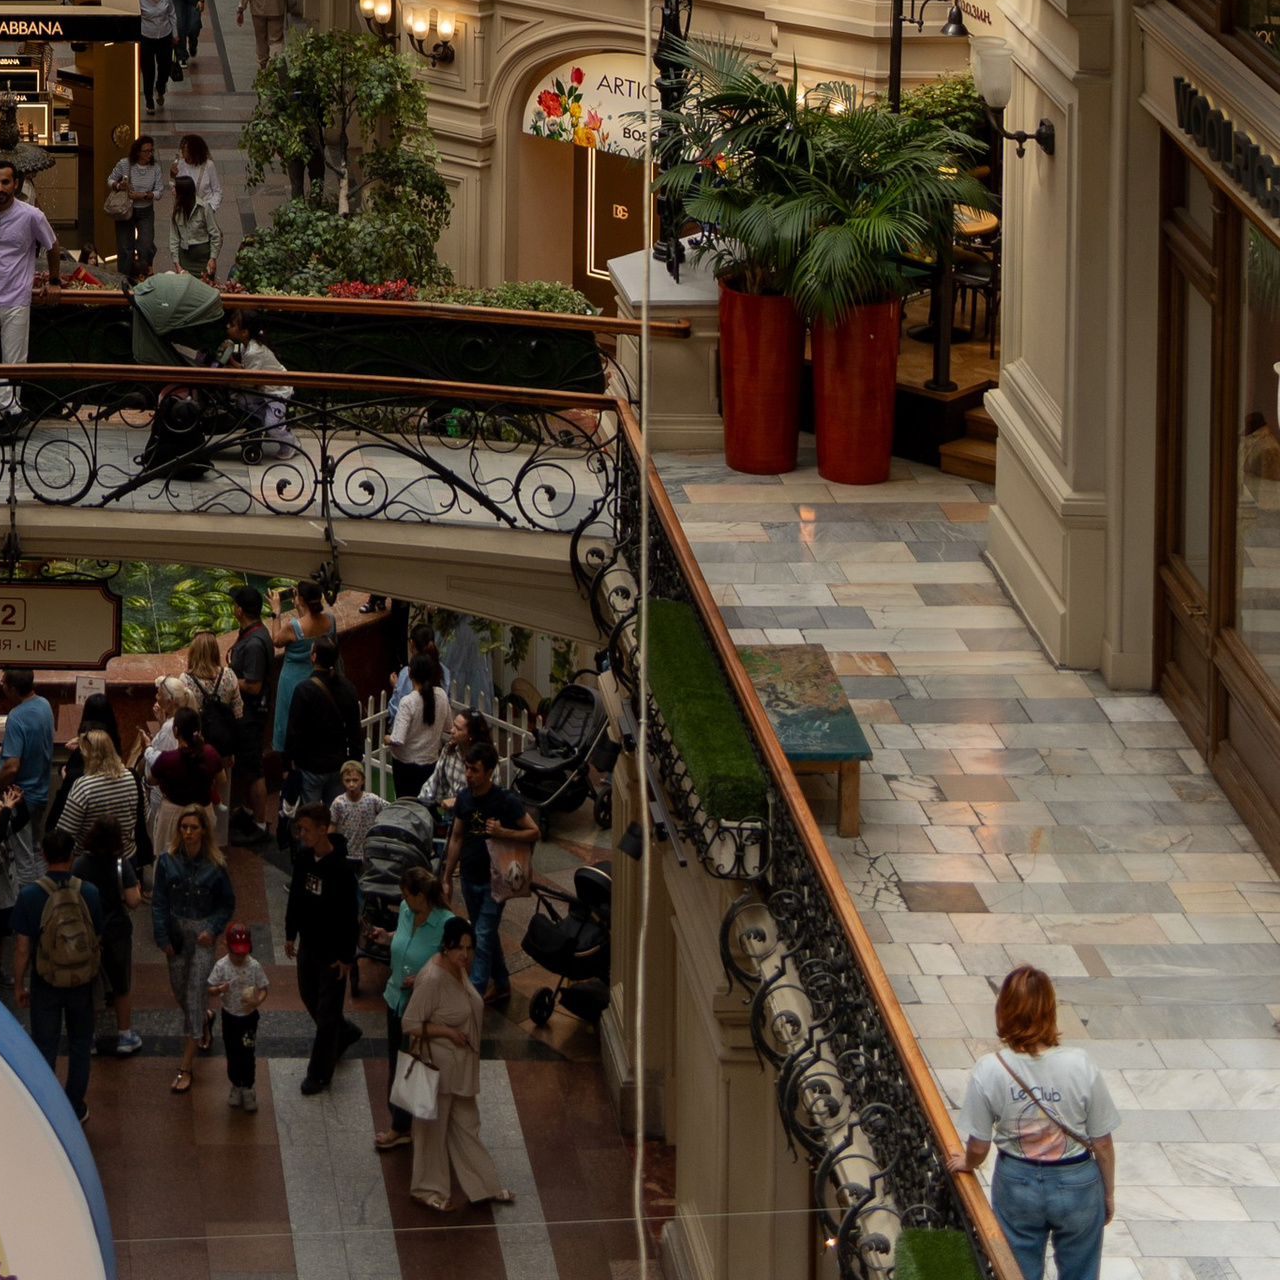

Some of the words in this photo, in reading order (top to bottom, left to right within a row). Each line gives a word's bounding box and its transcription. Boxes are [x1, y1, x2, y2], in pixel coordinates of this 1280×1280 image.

[1, 604, 16, 626] 2
[24, 640, 57, 652] LINE
[1011, 1086, 1027, 1101] Le
[1030, 1086, 1062, 1102] Club
